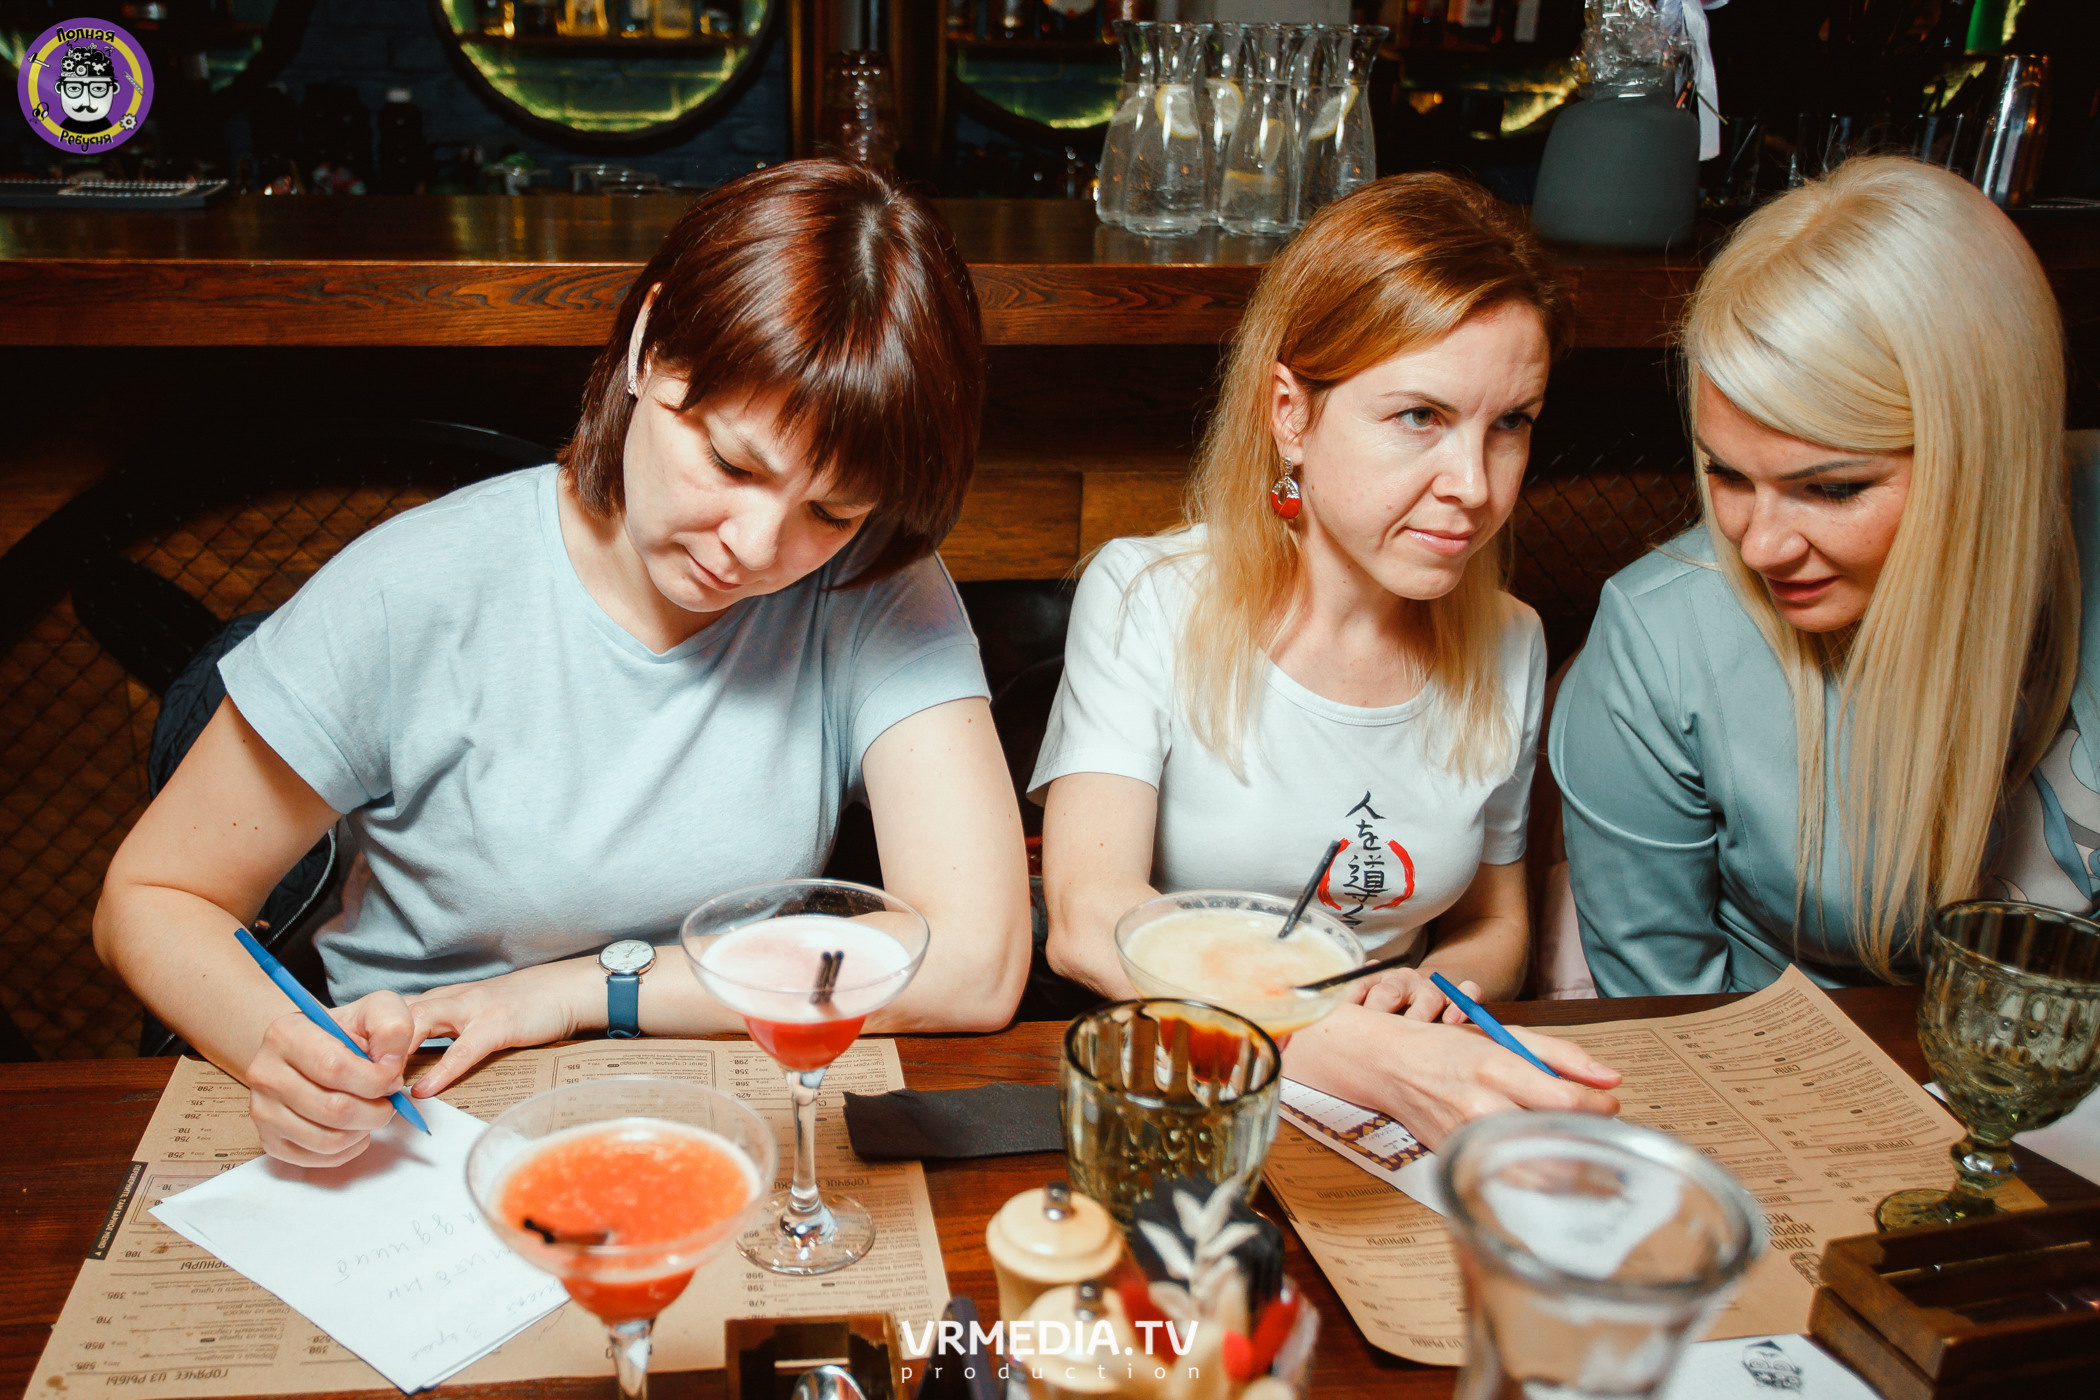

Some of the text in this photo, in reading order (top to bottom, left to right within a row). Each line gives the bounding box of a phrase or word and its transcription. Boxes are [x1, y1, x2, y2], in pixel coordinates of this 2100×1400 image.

[1773, 1064, 1800, 1074] СУПЫ
[1827, 1139, 1914, 1154] ГОРЯЧИЕ ЗАКУСКИ
[774, 1178, 870, 1190] ГОРЯЧИЕ ЗСКИ
[116, 1198, 126, 1210] ТАМ
[105, 1209, 120, 1232] БАРНОЕ
[1760, 1212, 1794, 1224] МЕС
[98, 1230, 111, 1249] МЕНЮ
[1366, 1235, 1416, 1246] ГАРНИРЫ
[1770, 1237, 1815, 1250] ОДНО
[180, 1260, 229, 1270] АРНИРЫ
[1408, 1337, 1445, 1349] РЫБЫ
[105, 1368, 229, 1386] ГОРЯЧЕЕ ИЗ РЫБЫ
